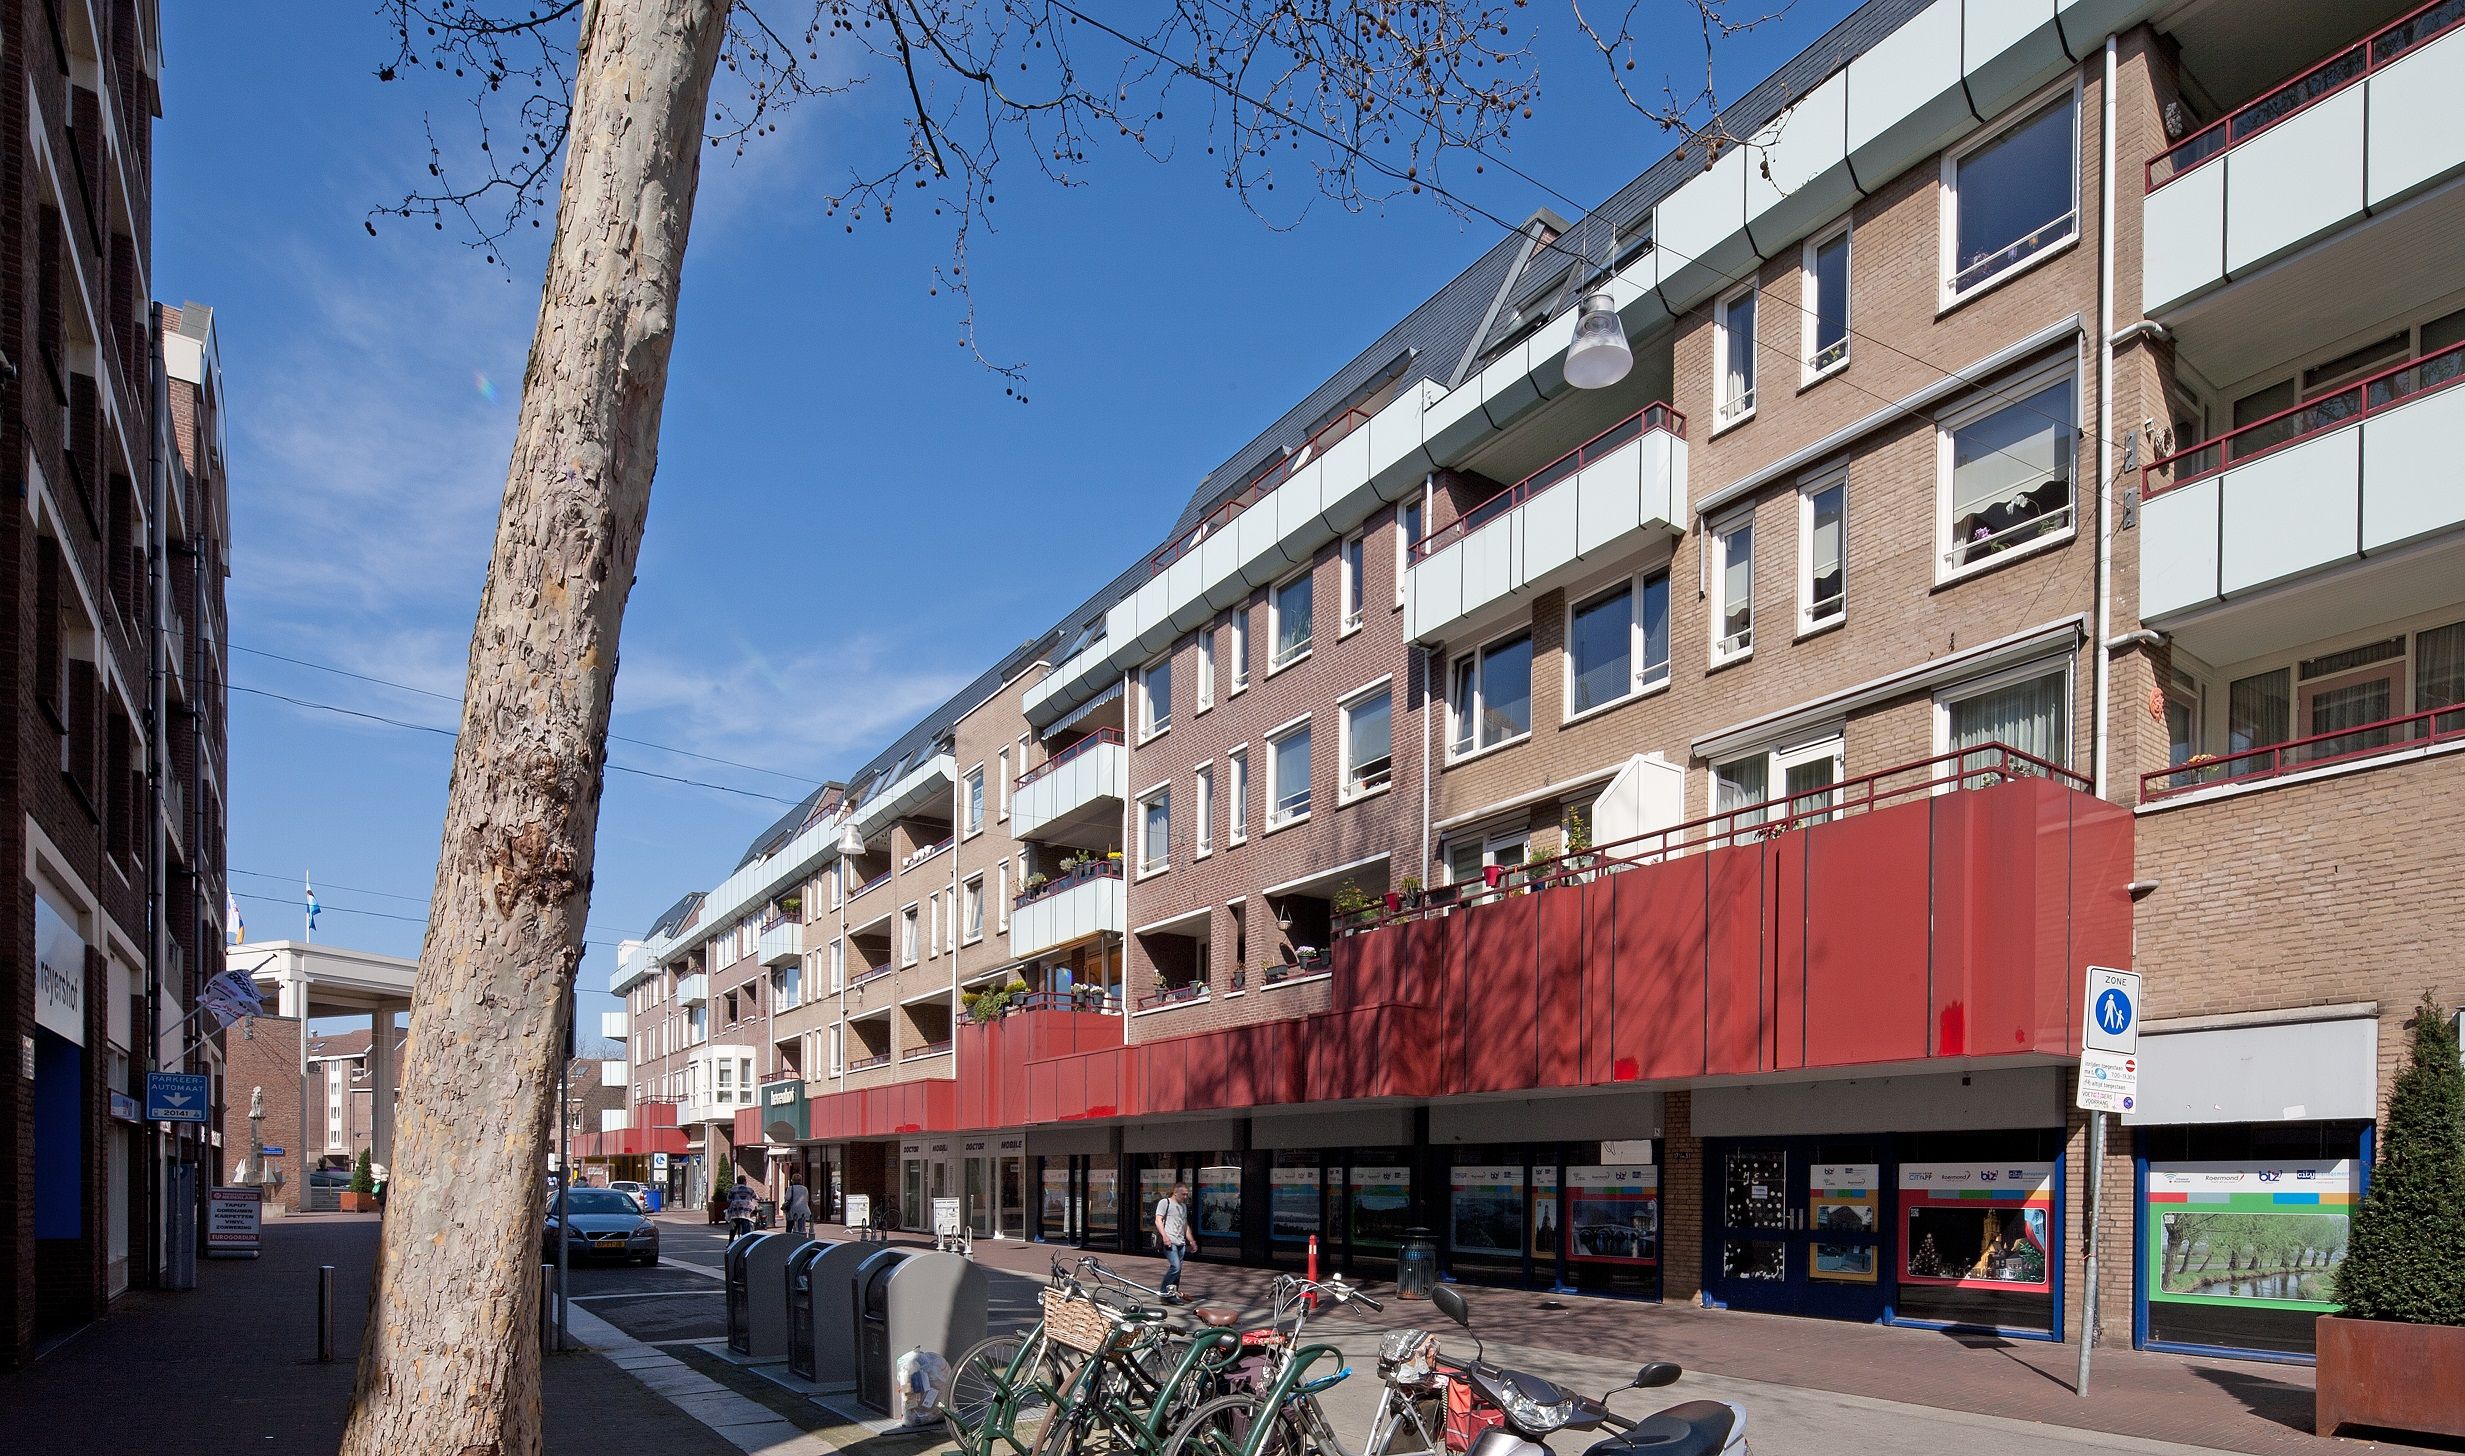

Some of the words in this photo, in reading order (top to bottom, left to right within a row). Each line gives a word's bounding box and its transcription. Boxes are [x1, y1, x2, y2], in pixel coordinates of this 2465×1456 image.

[2105, 975, 2127, 986] ZONE
[41, 960, 77, 1013] reyershof
[152, 1075, 203, 1083] PARKEER-
[151, 1084, 204, 1092] AUTOMAAT
[903, 1145, 920, 1153] DOCTOR
[965, 1142, 985, 1151] DOCTOR
[1001, 1140, 1023, 1149] MOBILE
[2297, 1170, 2316, 1180] city
